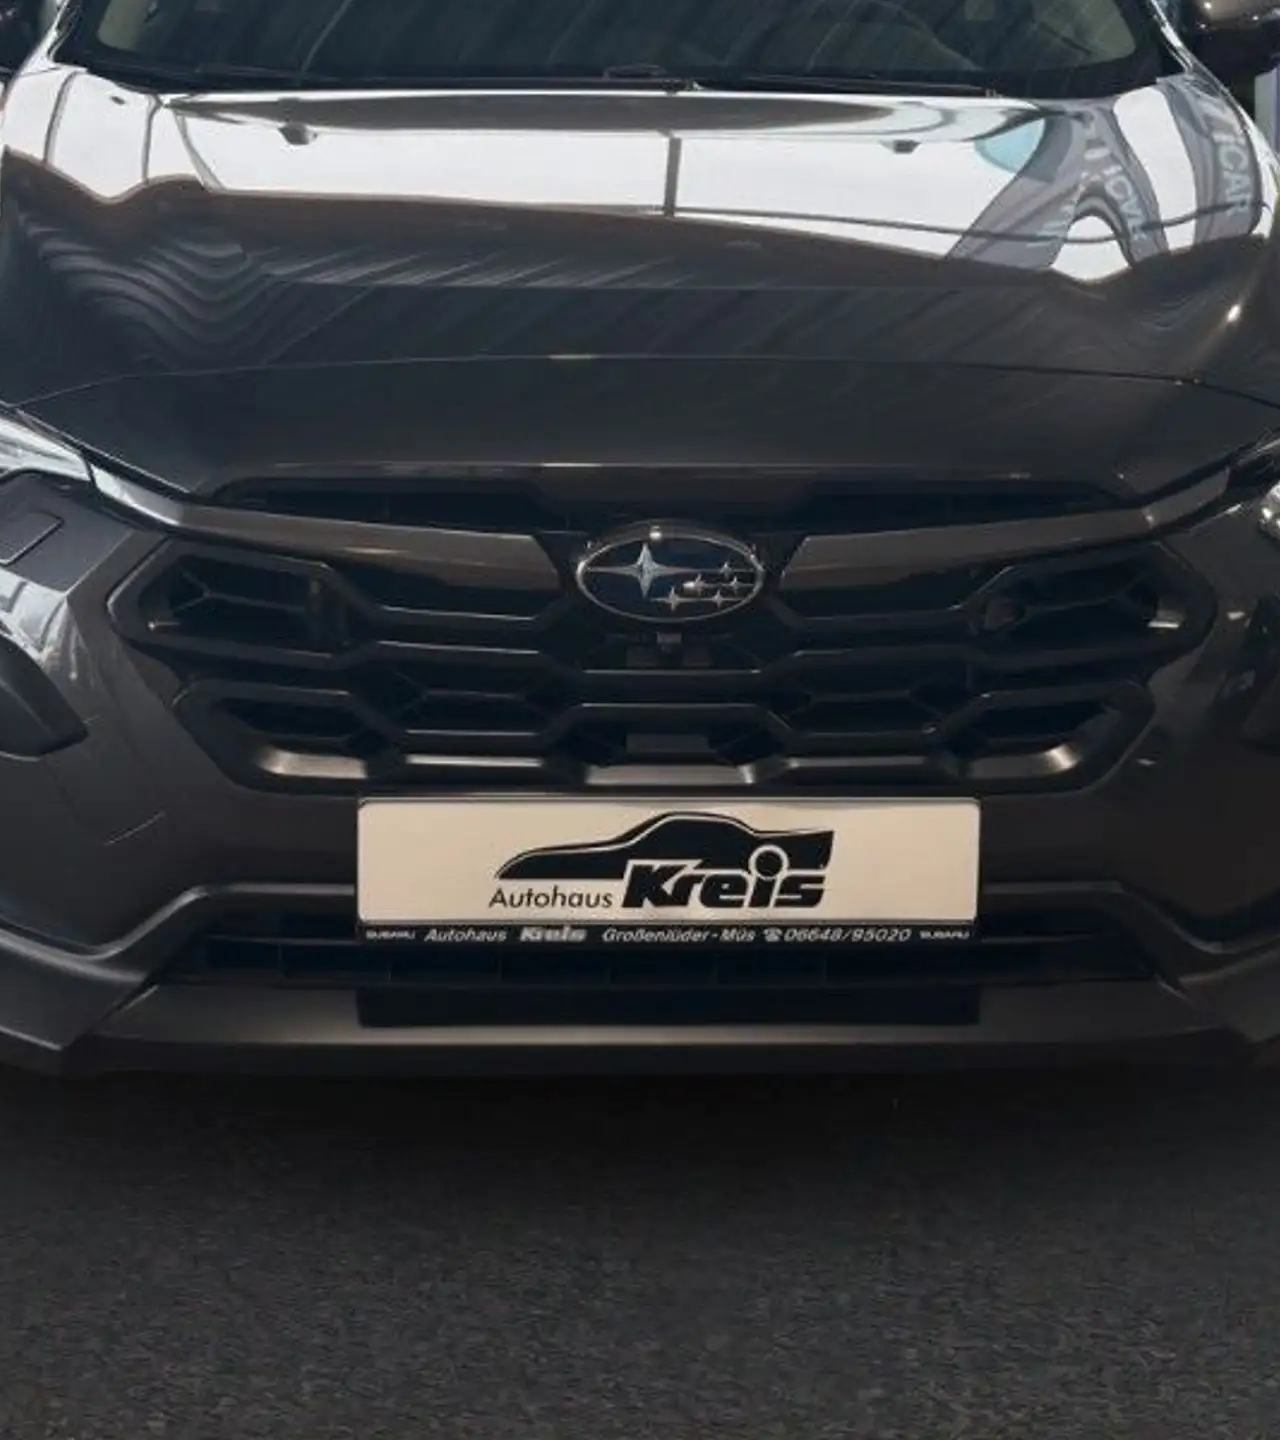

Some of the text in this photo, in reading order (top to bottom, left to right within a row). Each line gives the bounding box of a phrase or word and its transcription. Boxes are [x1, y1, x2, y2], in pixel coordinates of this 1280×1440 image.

[488, 848, 826, 909] Autohaus Kreis
[424, 927, 508, 942] Autohaus
